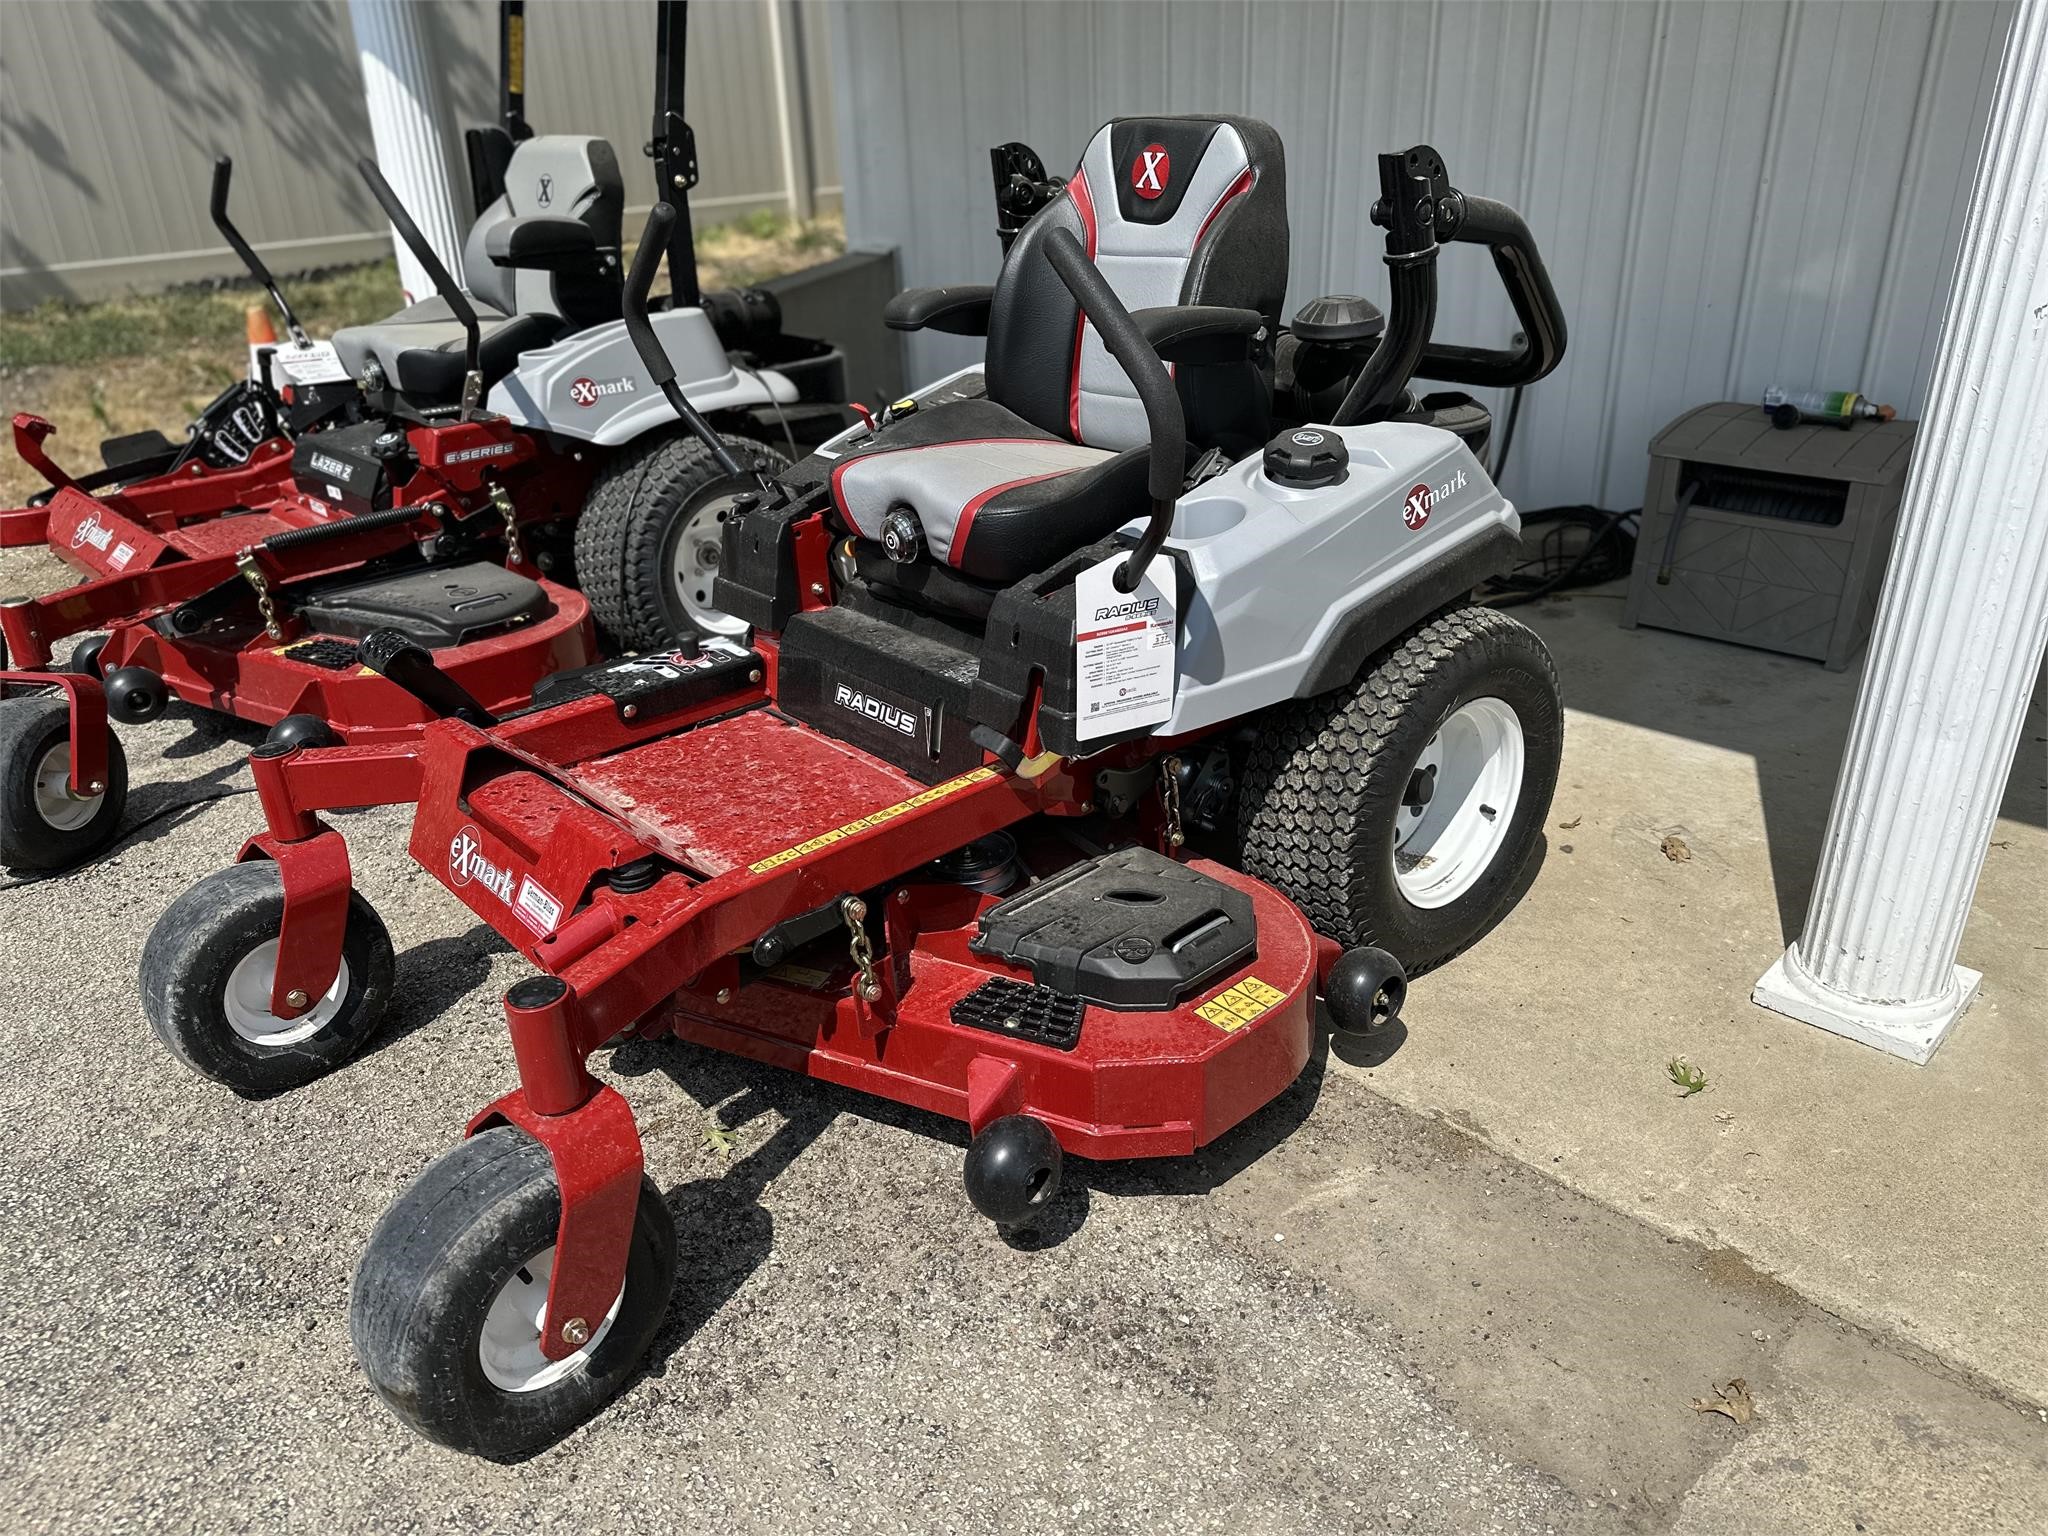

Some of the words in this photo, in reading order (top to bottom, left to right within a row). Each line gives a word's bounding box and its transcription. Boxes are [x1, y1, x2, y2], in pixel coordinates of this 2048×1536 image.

[1136, 152, 1165, 190] X
[538, 179, 551, 202] X
[570, 378, 635, 403] eXmark
[310, 451, 343, 478] LAZER
[342, 464, 353, 481] Z
[1402, 469, 1470, 526] eXmark
[75, 517, 113, 549] eXmark
[1095, 597, 1160, 621] RADIUS
[835, 684, 916, 736] RADIUS
[451, 833, 517, 908] eXmark
